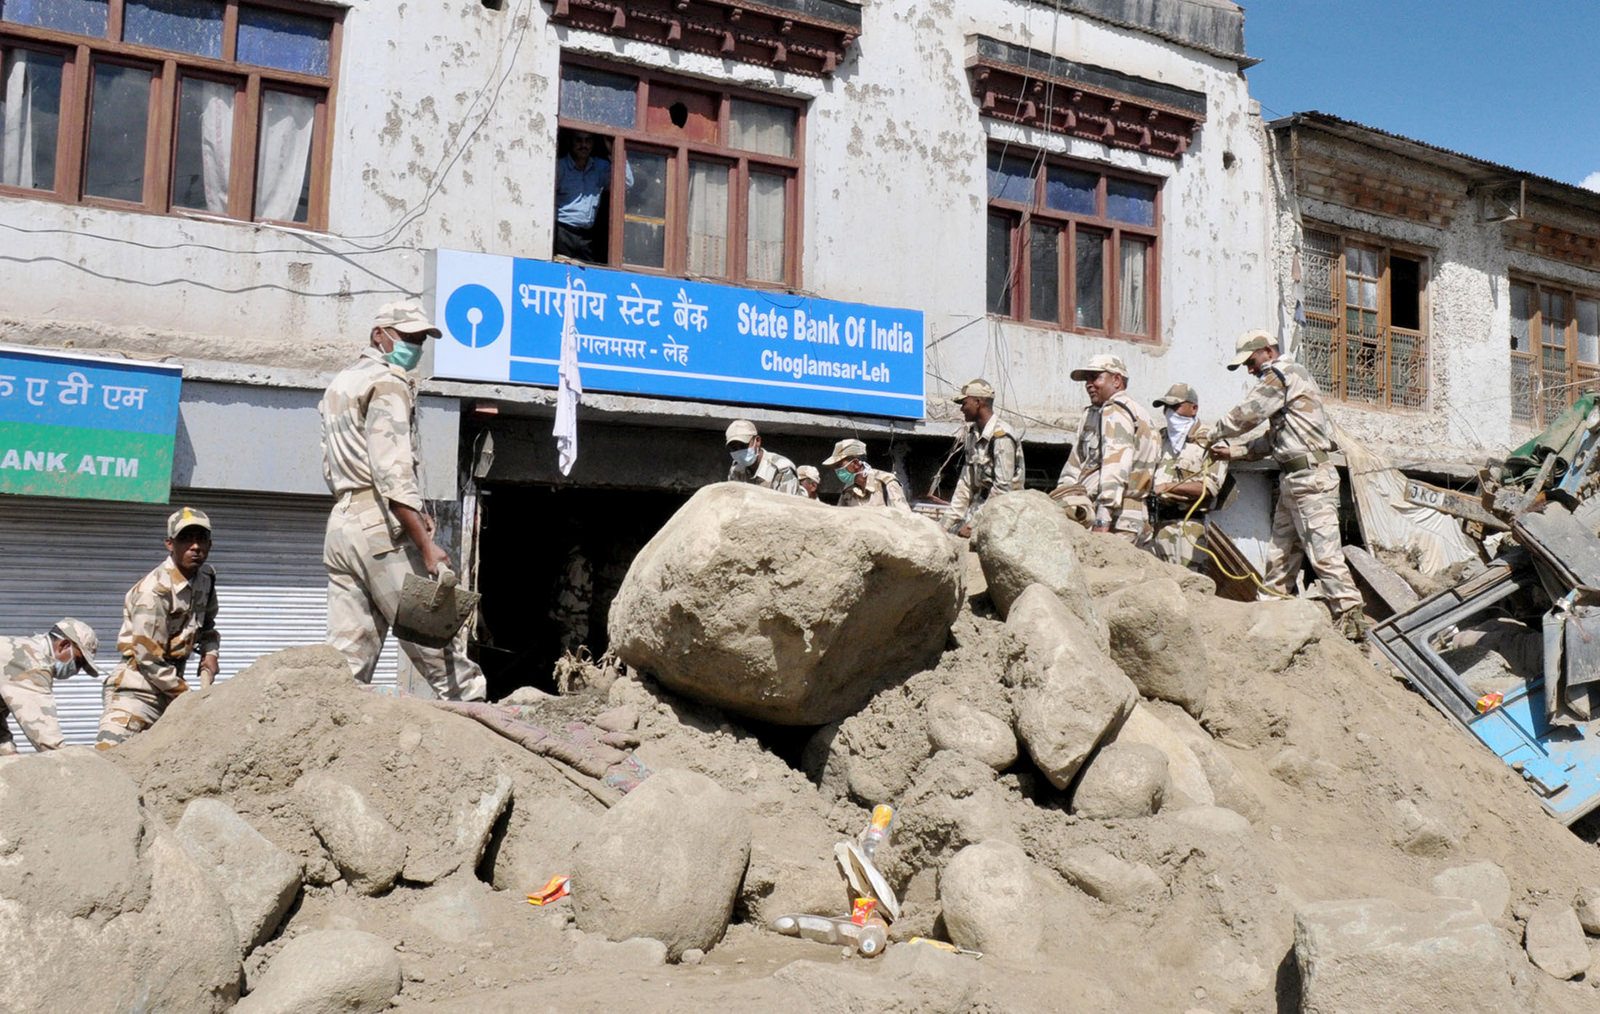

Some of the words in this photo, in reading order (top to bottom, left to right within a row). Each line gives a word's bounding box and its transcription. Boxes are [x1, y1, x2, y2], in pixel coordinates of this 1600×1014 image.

[617, 282, 663, 327] स्टेट
[672, 287, 709, 332] बैंक
[737, 302, 788, 340] State
[794, 309, 840, 346] Bank
[845, 316, 866, 348] Of
[871, 319, 914, 354] India
[662, 335, 690, 366] लेह
[761, 349, 890, 384] Choglamsar-Leh
[76, 454, 139, 478] ATM
